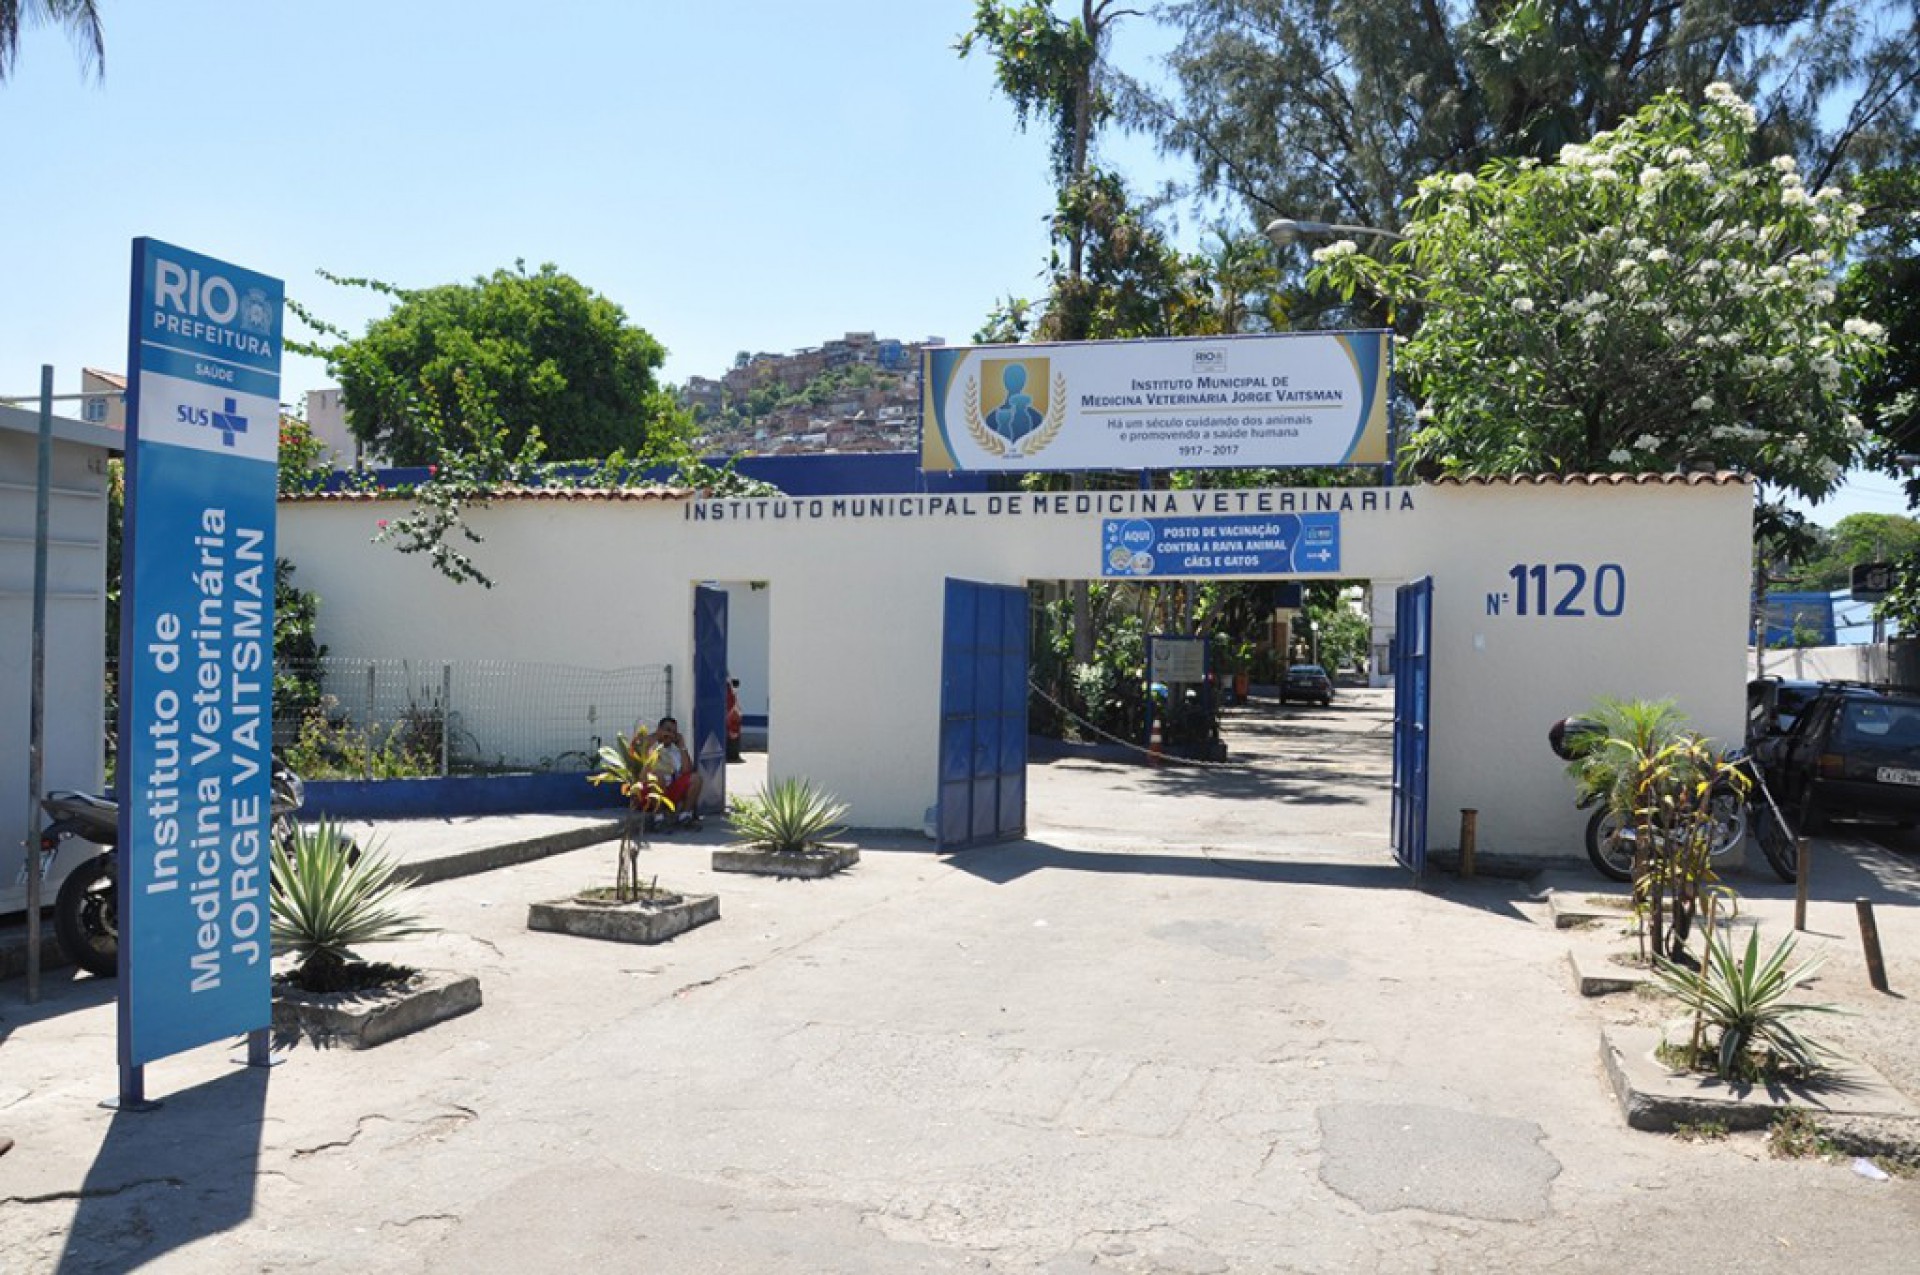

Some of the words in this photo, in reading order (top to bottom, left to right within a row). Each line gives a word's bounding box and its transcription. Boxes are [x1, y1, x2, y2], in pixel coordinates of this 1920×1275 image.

[155, 259, 238, 324] RIO
[154, 312, 272, 357] PREFEITURA
[1195, 352, 1215, 361] RIO
[195, 363, 234, 382] SAÚDE
[1132, 379, 1193, 391] INSTITUTO
[1197, 377, 1268, 389] MUNICIPAL
[1272, 376, 1289, 387] DE
[1081, 395, 1142, 407] MEDICINA
[1232, 391, 1272, 403] JORGE
[1276, 389, 1343, 402] VAITSMAN
[177, 404, 209, 426] SUS
[1108, 418, 1123, 428] Há
[1125, 420, 1142, 428] um
[1146, 416, 1182, 428] século
[1185, 416, 1239, 427] cuidando
[1241, 416, 1263, 426] dos
[1265, 414, 1313, 425] animais
[1120, 432, 1127, 440] e
[1130, 429, 1200, 441] promovendo
[1203, 431, 1210, 439] a
[1213, 428, 1248, 439] saúde
[1250, 428, 1299, 438] humana
[1179, 445, 1203, 456] 1917
[1212, 444, 1239, 456] 2017
[685, 501, 823, 521] INSTITUTO
[832, 497, 976, 518] MUNICIPAL
[988, 496, 1021, 515] DE
[1034, 494, 1177, 514] MEDICINA
[1192, 490, 1414, 512] VETERINARIA
[1124, 530, 1150, 544] AQUI
[1164, 527, 1199, 538] POSTO
[1202, 526, 1216, 537] DE
[1218, 524, 1280, 539] VACINAÇÃO
[1156, 542, 1200, 553] CONTRA
[1203, 542, 1211, 552] A
[1213, 541, 1244, 551] RAIVA
[1246, 539, 1287, 550] ANIMAL
[1215, 556, 1220, 567] E
[1225, 555, 1259, 566] GATOS
[1509, 564, 1626, 617] 1120
[148, 613, 181, 673] de
[191, 508, 226, 766] Veterinária
[232, 528, 265, 787] VAITSMAN
[146, 690, 179, 895] Instituto
[190, 776, 221, 993] Medicina
[231, 795, 260, 966] JORGE
